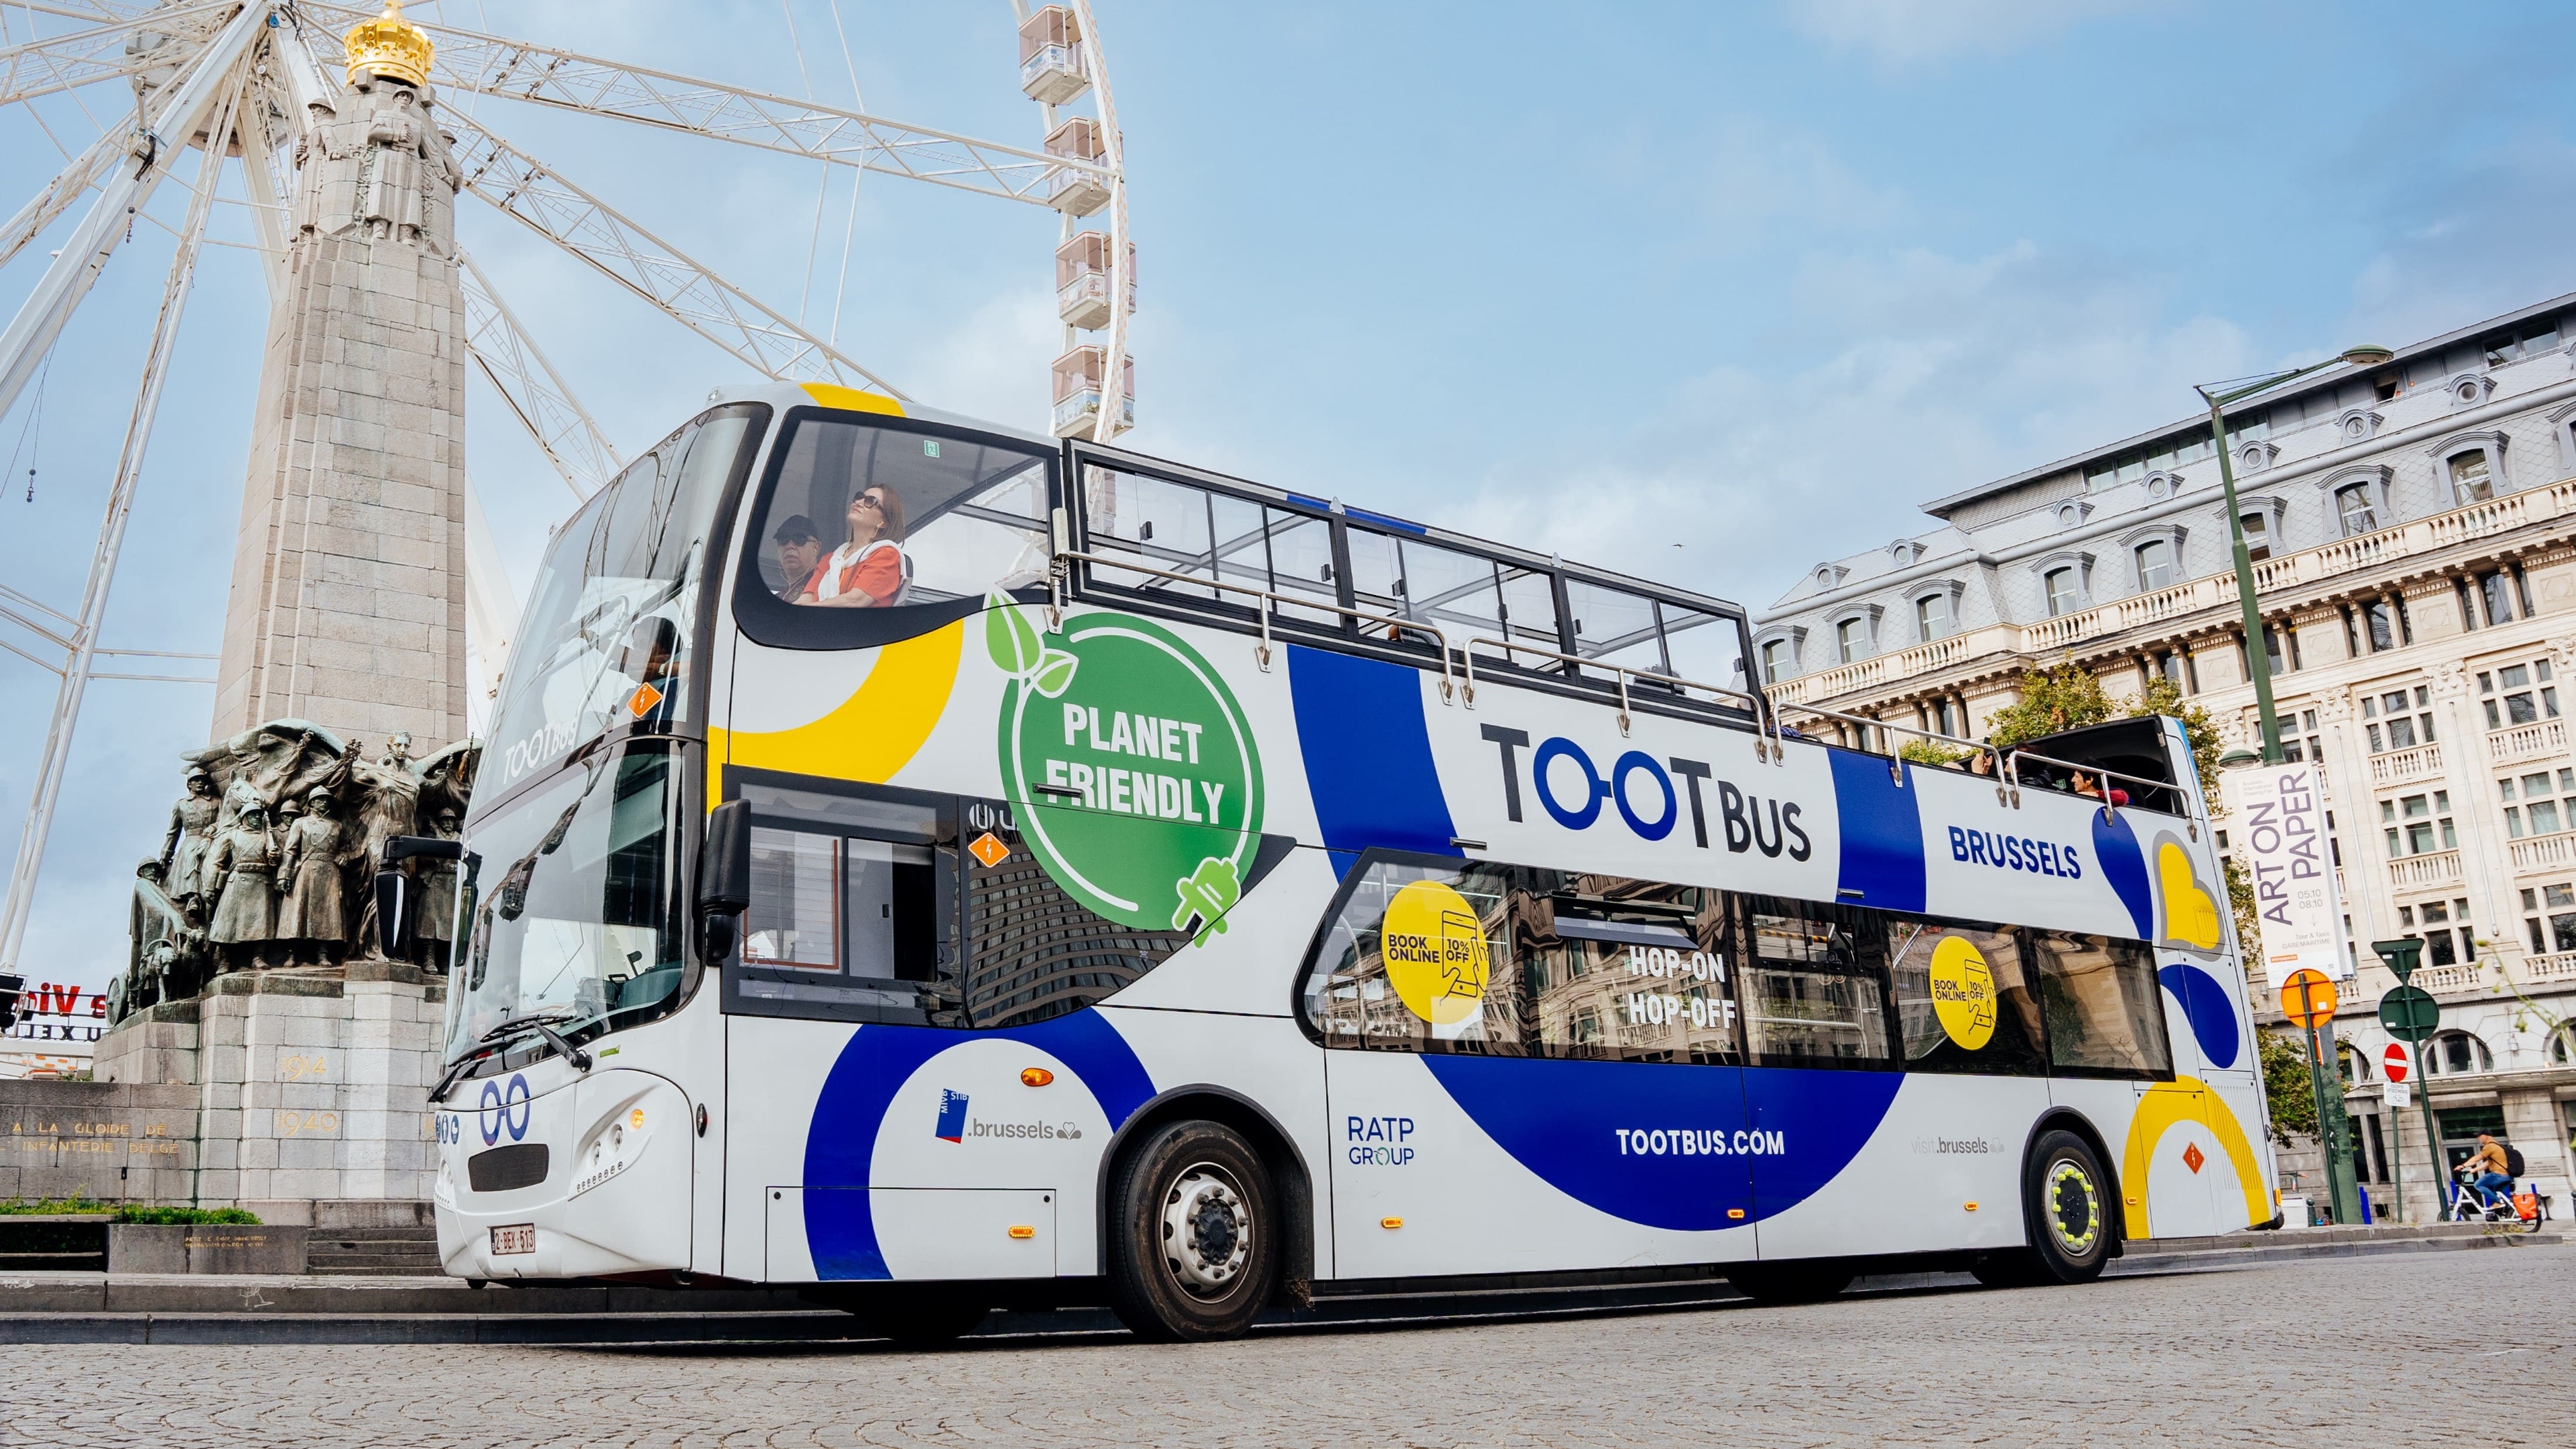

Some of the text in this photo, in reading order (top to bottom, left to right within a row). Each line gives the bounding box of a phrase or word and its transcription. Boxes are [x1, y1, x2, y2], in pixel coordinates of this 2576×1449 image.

[1063, 703, 1203, 764] PLANET
[1046, 759, 1224, 824] FRIENDLY
[1481, 723, 1811, 862] TOOTBUS
[2279, 770, 2321, 879] PAPER
[1948, 825, 2081, 879] BRUSSELS
[2246, 801, 2293, 926] ART ON
[2297, 889, 2321, 899] 05.10
[2299, 899, 2323, 909] 08.10
[1388, 934, 1428, 949] BOOK
[1447, 938, 1469, 953] 10%
[2300, 938, 2331, 947] MARITIME
[1389, 948, 1440, 963] ONLINE
[1446, 950, 1469, 963] OFF
[1629, 946, 1725, 982] HOP-ON
[1934, 979, 1958, 991] BOOK
[1969, 981, 1984, 992] 10%
[1936, 990, 1967, 1001] ONLINE
[1969, 991, 1984, 1001] OFF
[1628, 993, 1735, 1029] HOP-OFF
[282, 1055, 326, 1080] 1914
[951, 1091, 968, 1101] STIB
[12, 1122, 167, 1136] A LA GLOIRE DE
[278, 1112, 338, 1137] 1940
[968, 1118, 1054, 1139] .brussels
[1348, 1116, 1414, 1142] RATP
[23, 1141, 114, 1153] INFANTERIE
[129, 1142, 179, 1154] BELGE
[1615, 1129, 1784, 1155] TOOTBUS.COM
[1349, 1146, 1414, 1166] GROUP
